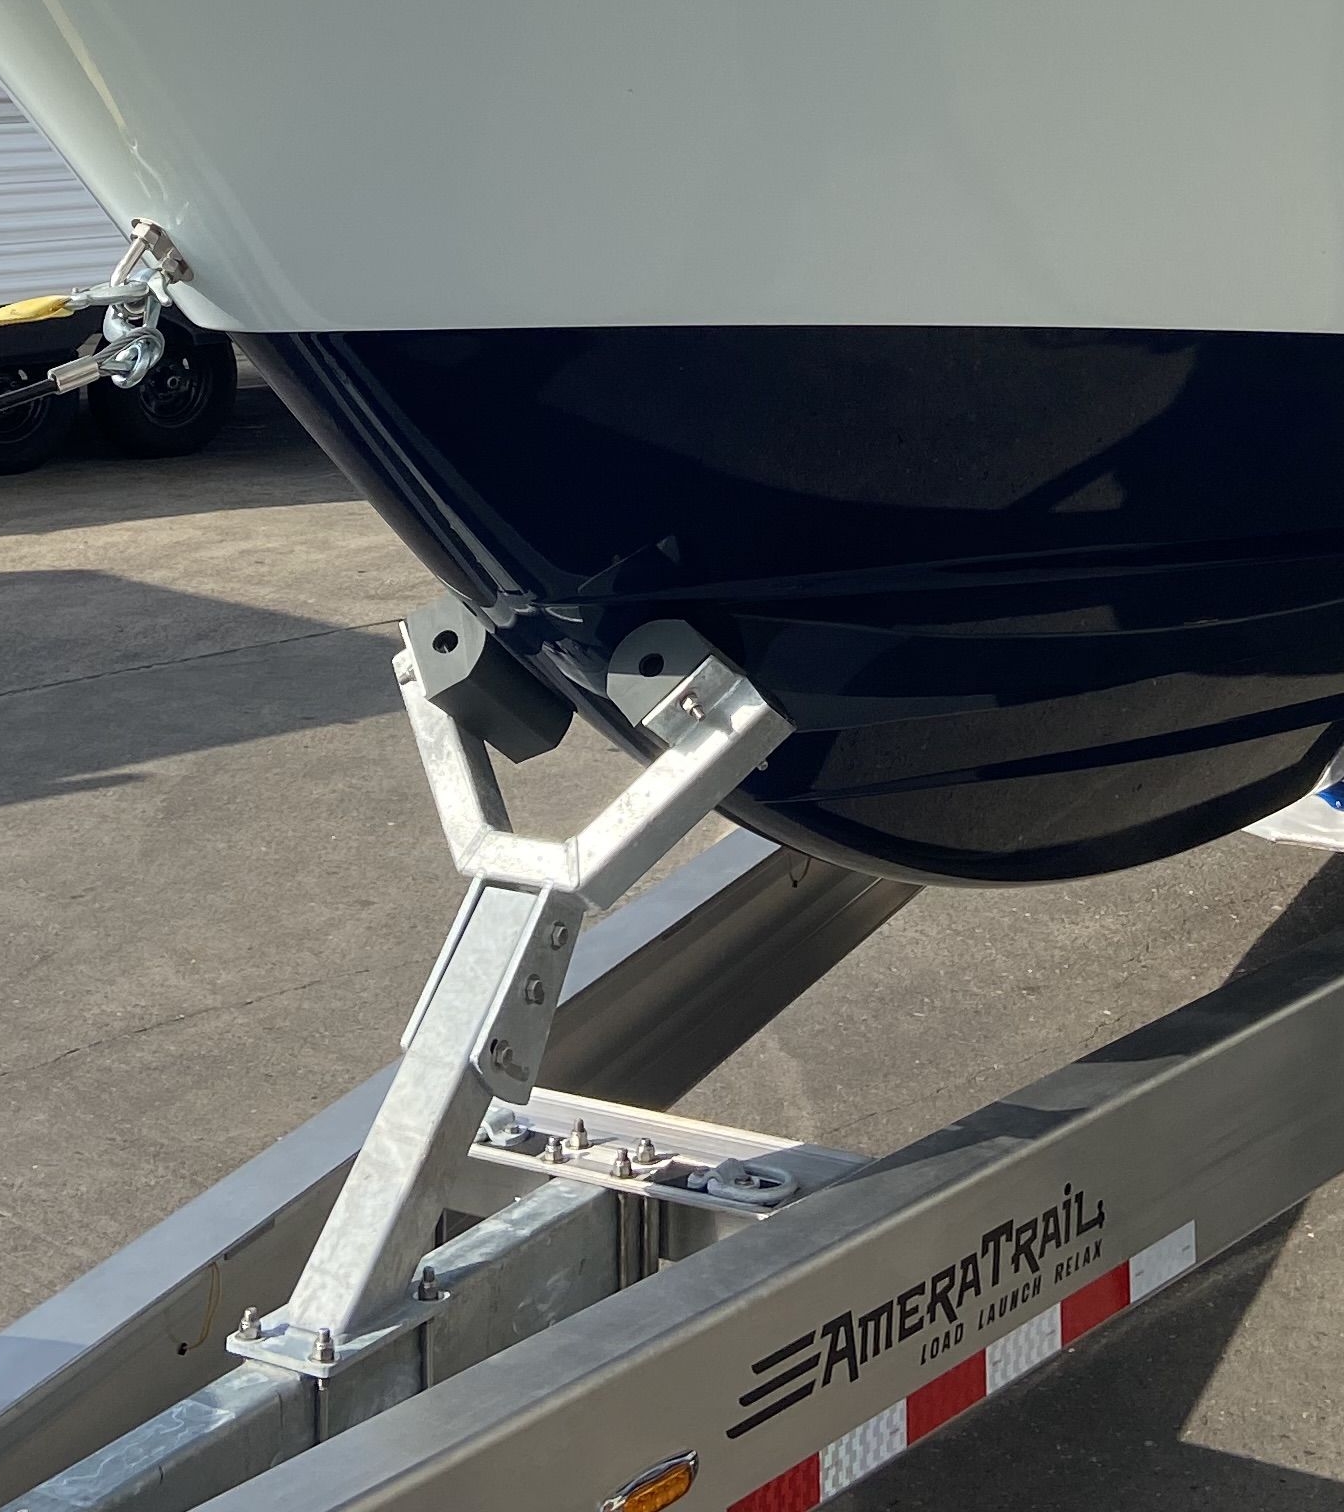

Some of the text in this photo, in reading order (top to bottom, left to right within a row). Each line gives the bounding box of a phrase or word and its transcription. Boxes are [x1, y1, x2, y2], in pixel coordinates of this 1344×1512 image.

[920, 1239, 1103, 1366] LOAD LAUNCH RELAX
